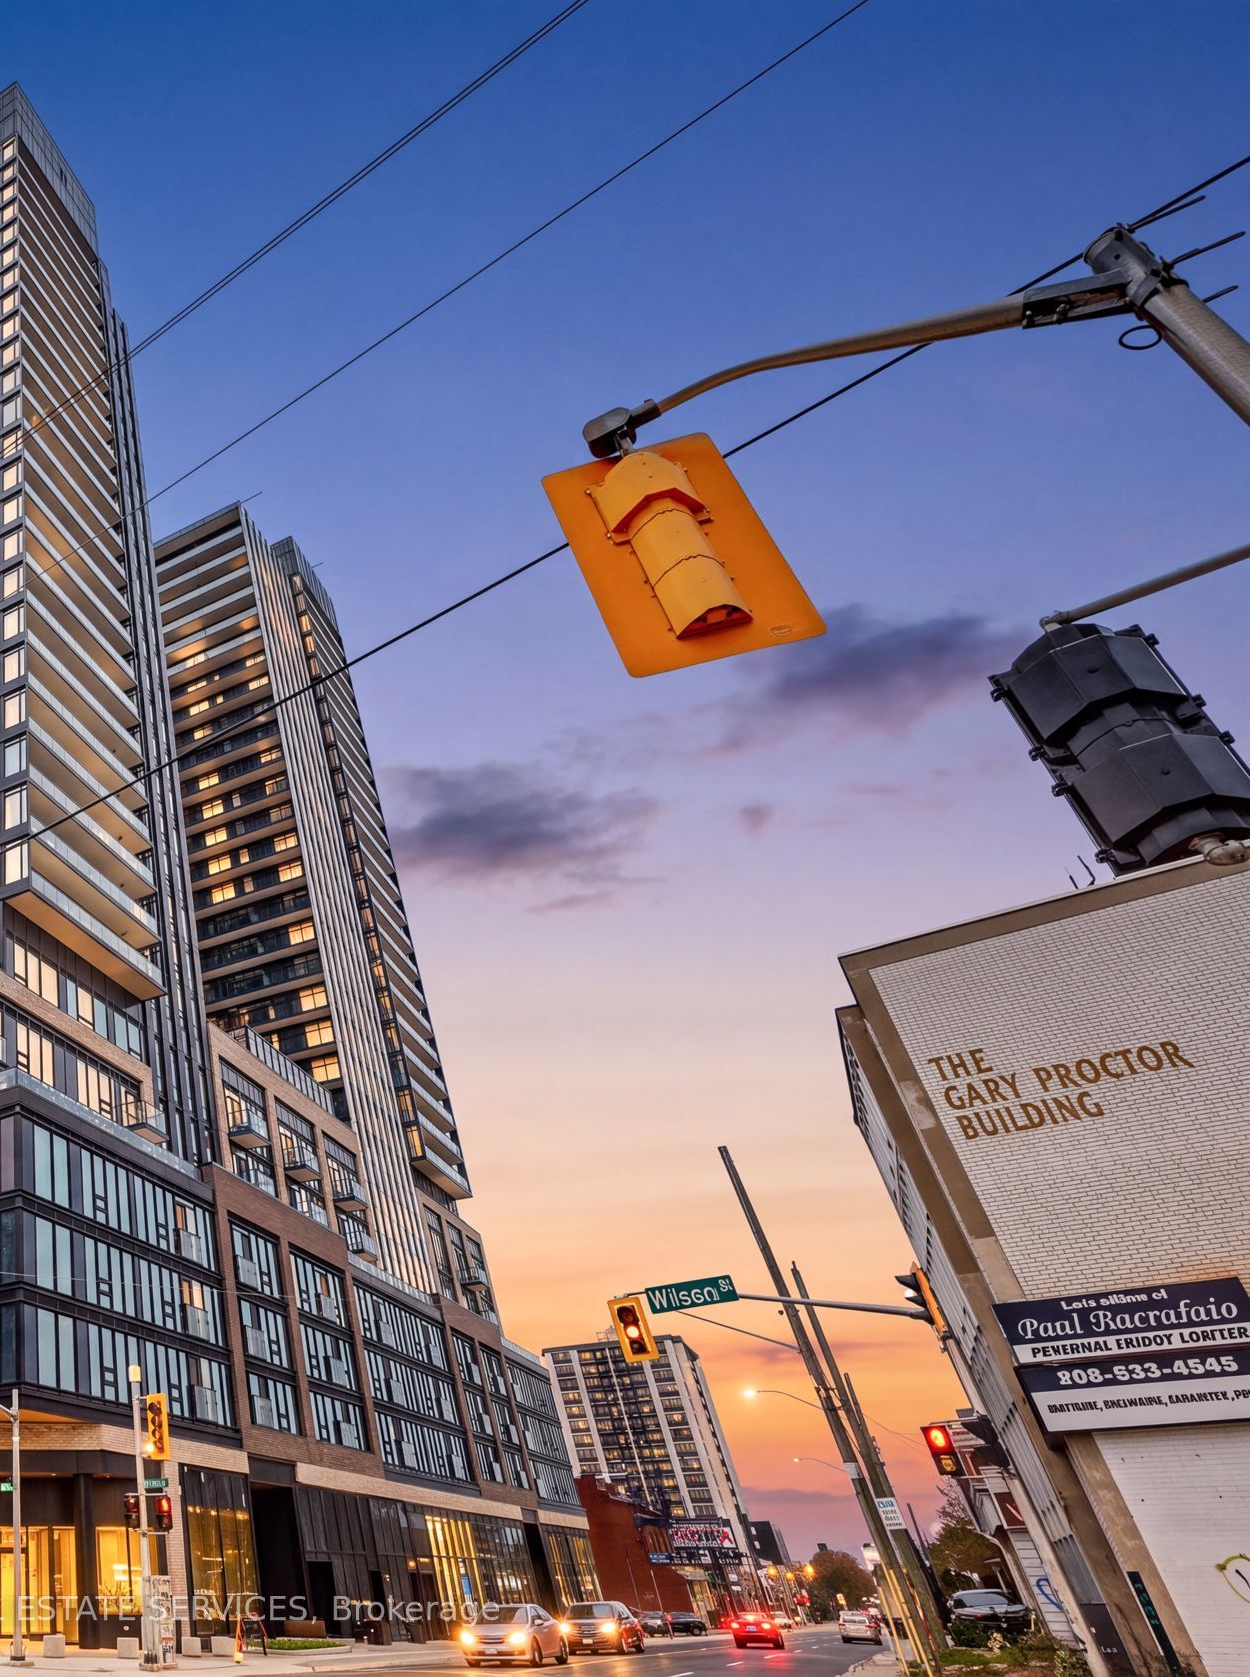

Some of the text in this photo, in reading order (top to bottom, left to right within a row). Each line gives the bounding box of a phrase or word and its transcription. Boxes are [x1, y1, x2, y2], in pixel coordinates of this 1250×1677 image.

[927, 1048, 993, 1081] THE
[944, 1040, 1196, 1110] GARY PROCTOR
[955, 1091, 1105, 1140] BUILDING
